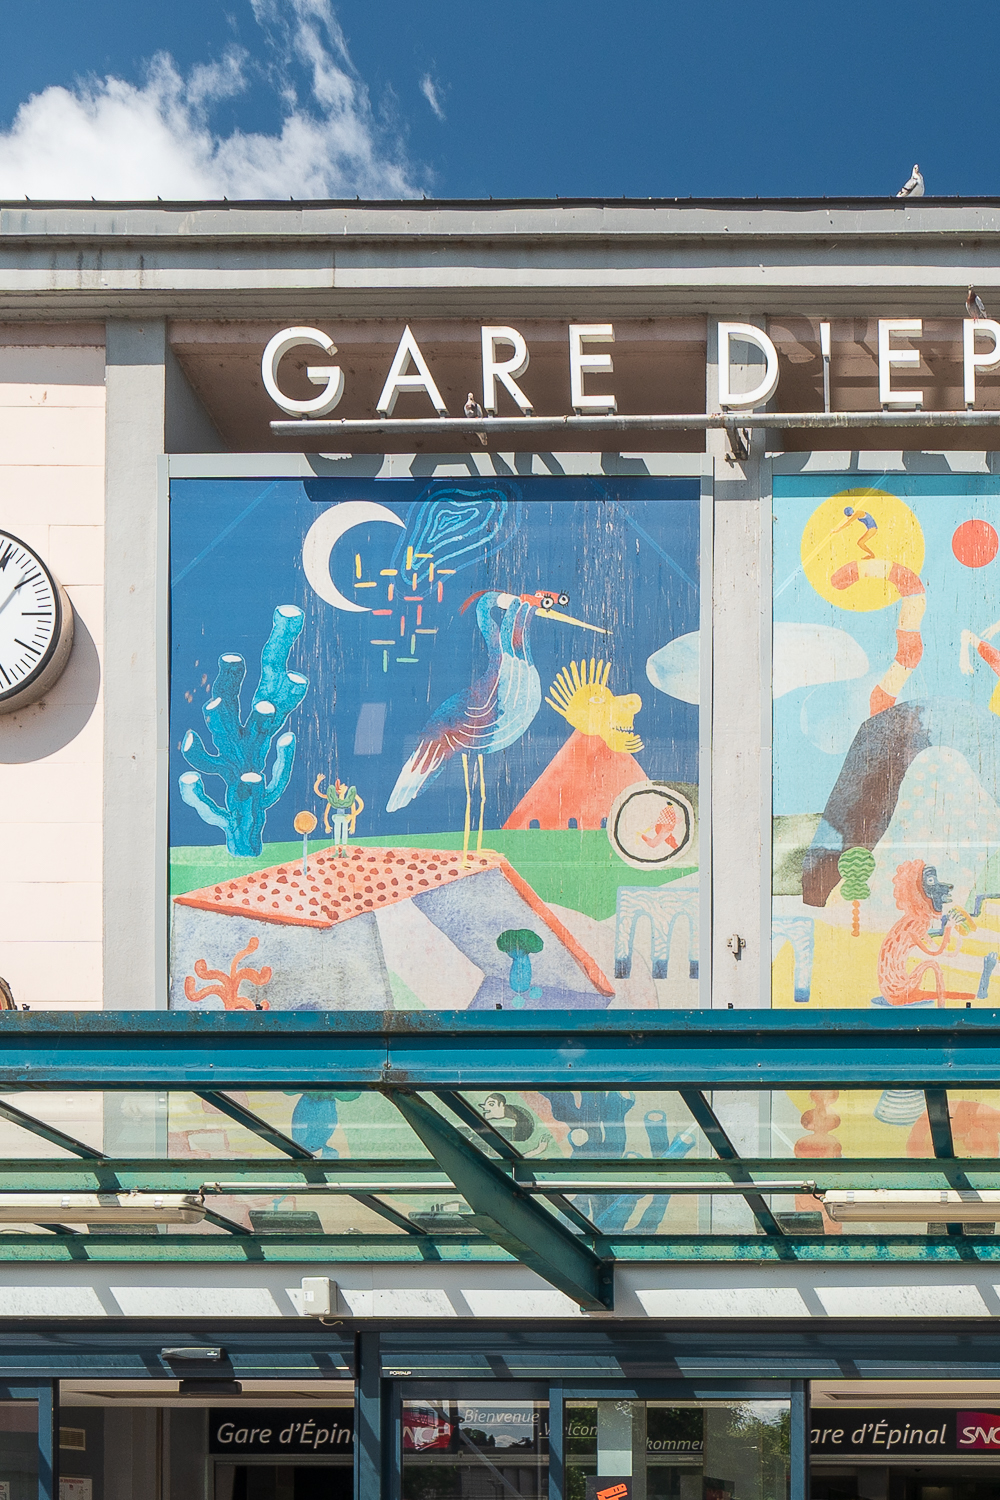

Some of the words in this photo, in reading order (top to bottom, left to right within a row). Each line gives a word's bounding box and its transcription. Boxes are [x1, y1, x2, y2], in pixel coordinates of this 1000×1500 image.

[261, 323, 618, 419] GARE
[216, 1422, 272, 1444] Gare
[279, 1418, 355, 1449] d'Épin
[810, 1427, 845, 1444] are
[851, 1419, 947, 1450] d'Épinal
